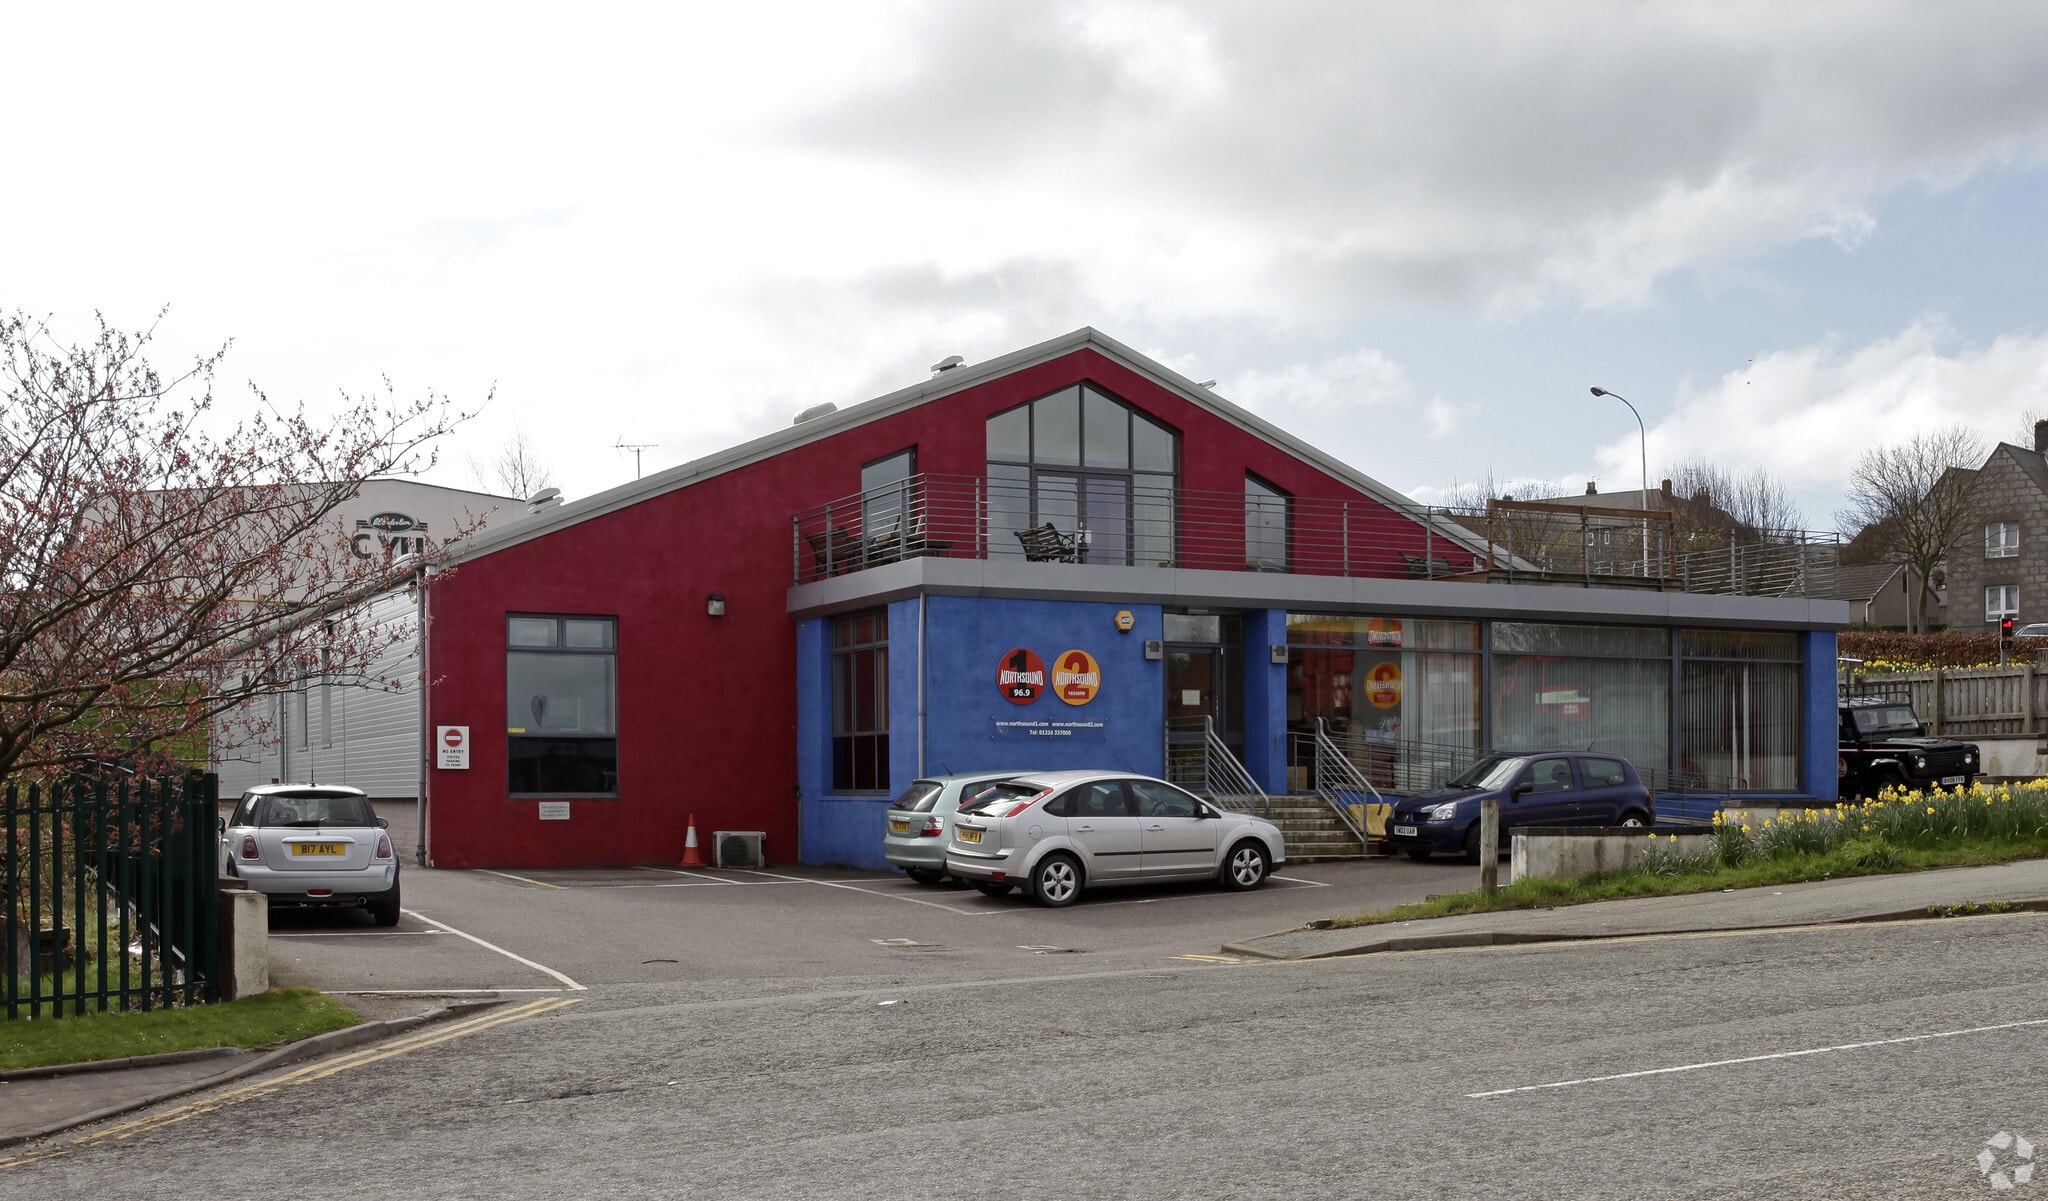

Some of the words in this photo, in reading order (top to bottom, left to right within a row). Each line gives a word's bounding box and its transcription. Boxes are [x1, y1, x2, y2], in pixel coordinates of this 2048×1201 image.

[1000, 669, 1044, 686] NORTHSOUND
[1055, 671, 1098, 687] NORTHSOUND
[1013, 689, 1031, 697] 96.9
[301, 845, 316, 854] B17
[319, 844, 337, 854] AYL
